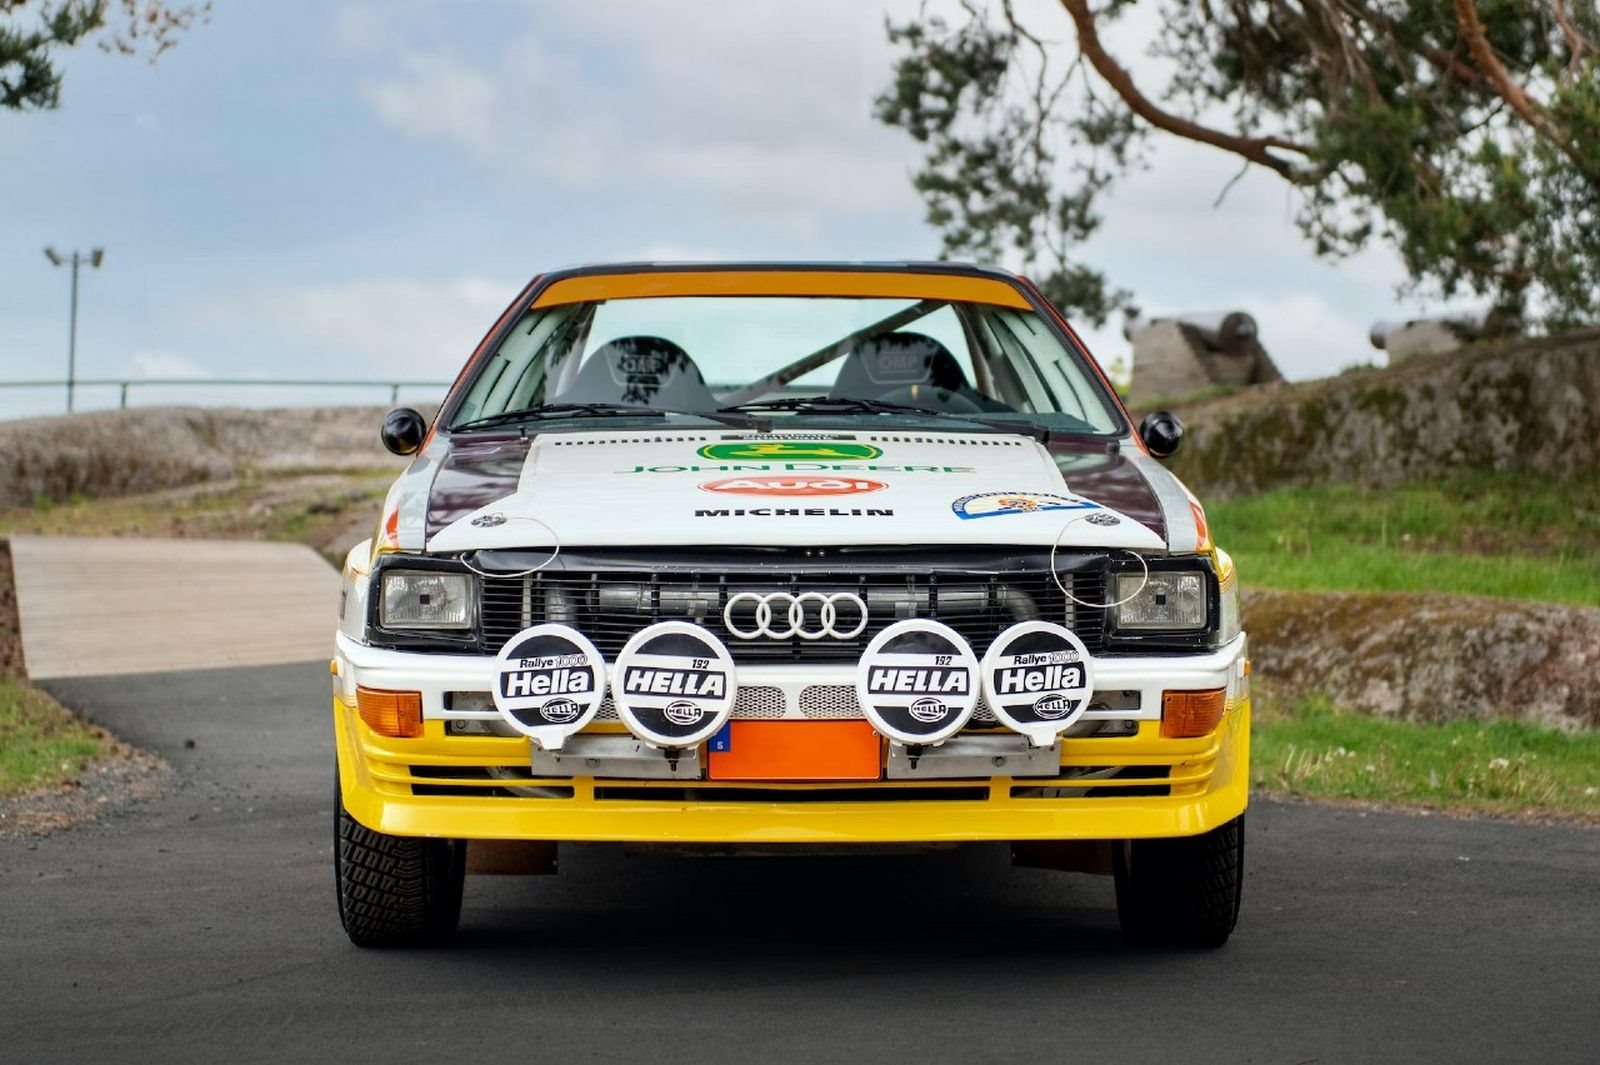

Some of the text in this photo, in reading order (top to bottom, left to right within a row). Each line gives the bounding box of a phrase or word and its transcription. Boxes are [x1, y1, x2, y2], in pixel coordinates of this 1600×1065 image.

[613, 463, 976, 474] JOHN DEERE
[694, 508, 894, 517] MICHELIN
[520, 654, 588, 669] Rallye 1000
[692, 659, 709, 669] 192
[935, 656, 952, 665] 192
[1014, 650, 1079, 666] Rallye 1000
[507, 670, 588, 696] Hella
[626, 671, 725, 696] HELLA
[870, 669, 967, 691] HELLA
[1002, 666, 1080, 692] Hella
[544, 703, 579, 715] HELLA
[668, 705, 702, 717] HELLA
[912, 703, 946, 714] HELLA
[1037, 699, 1070, 711] HELLA
[717, 741, 723, 749] S
